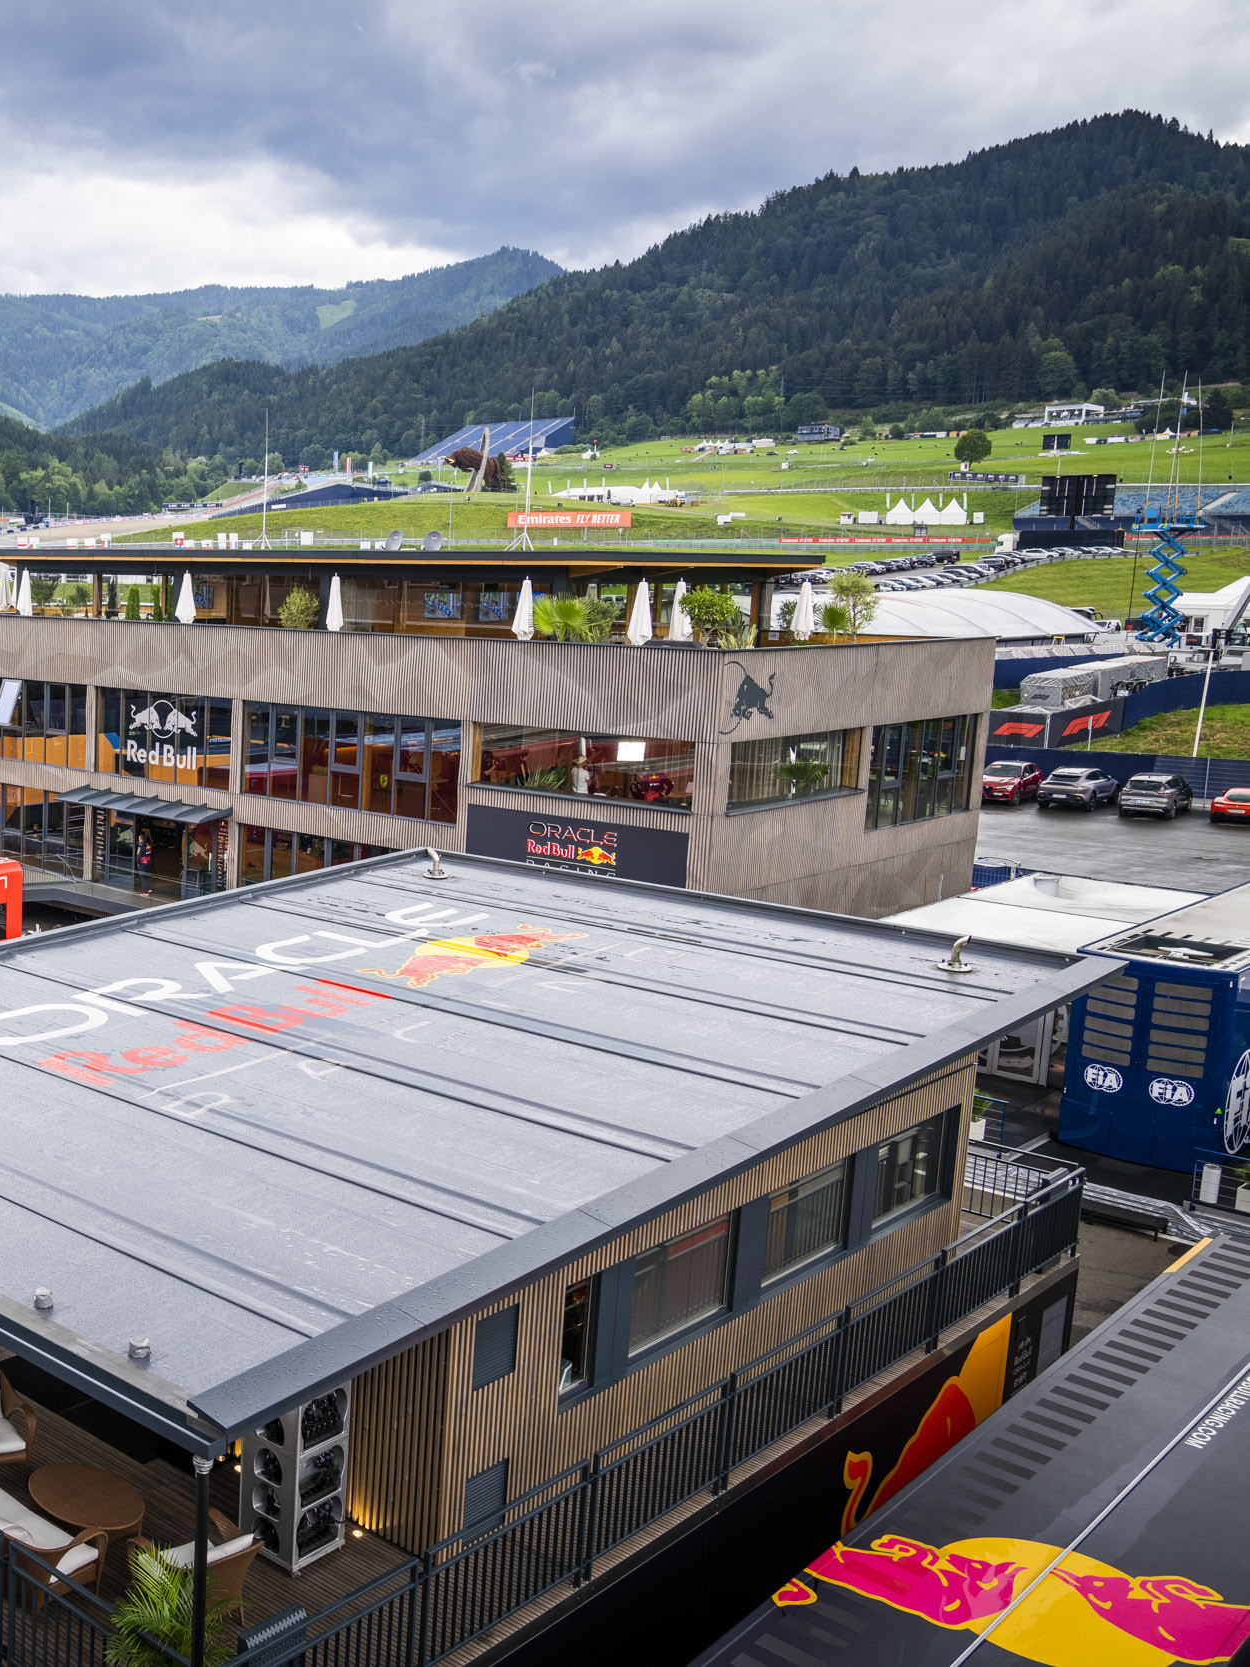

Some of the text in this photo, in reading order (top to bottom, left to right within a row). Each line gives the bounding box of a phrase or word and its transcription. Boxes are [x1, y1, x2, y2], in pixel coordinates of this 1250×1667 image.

[518, 514, 621, 524] Emirates FLY BETTER
[993, 722, 1046, 737] F1
[1061, 710, 1112, 737] F1
[126, 739, 197, 771] Red Bull
[527, 821, 618, 848] ORACLE
[526, 839, 576, 859] Red Bull
[36, 977, 392, 1087] Red Bull
